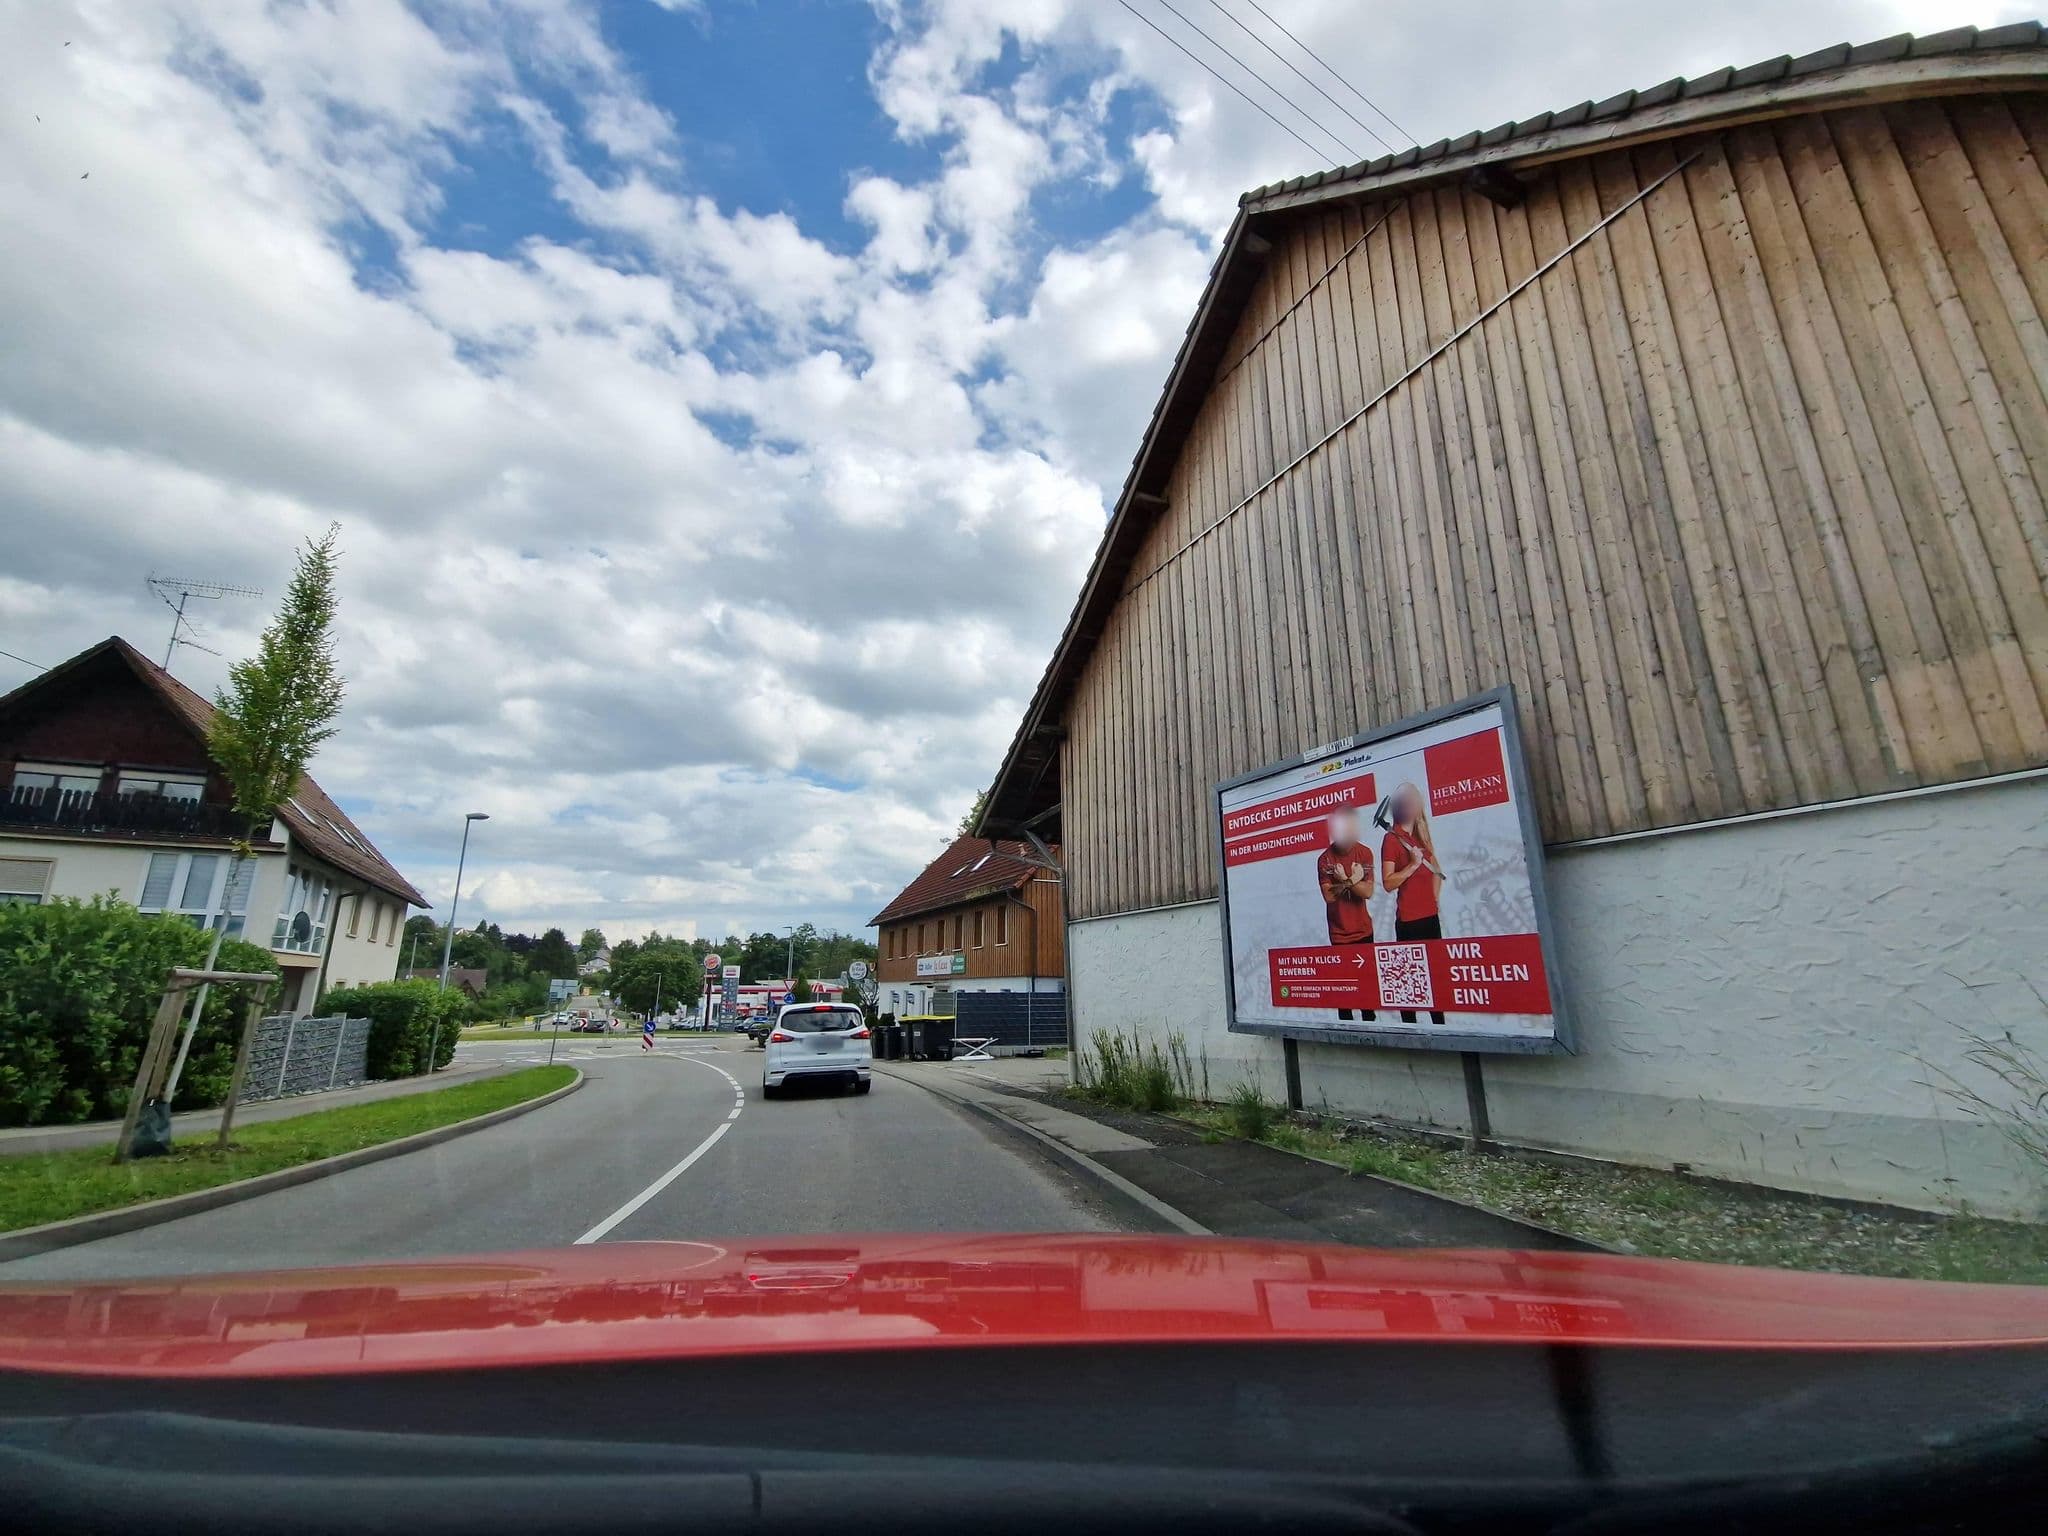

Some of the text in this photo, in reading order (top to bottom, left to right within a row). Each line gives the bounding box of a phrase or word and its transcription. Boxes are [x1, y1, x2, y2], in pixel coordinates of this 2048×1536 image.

[1228, 787, 1356, 830] ENTDECKE DEINE ZUKUNFT
[1230, 831, 1315, 857] IN DER MEDIZINTECHNIK
[1278, 955, 1341, 966] MIT NUR 7 KLICKS
[1446, 942, 1483, 960] WIR
[1278, 967, 1317, 976] BEWERBEN
[1450, 963, 1529, 982] STELLEN
[1453, 987, 1490, 1006] EIN!
